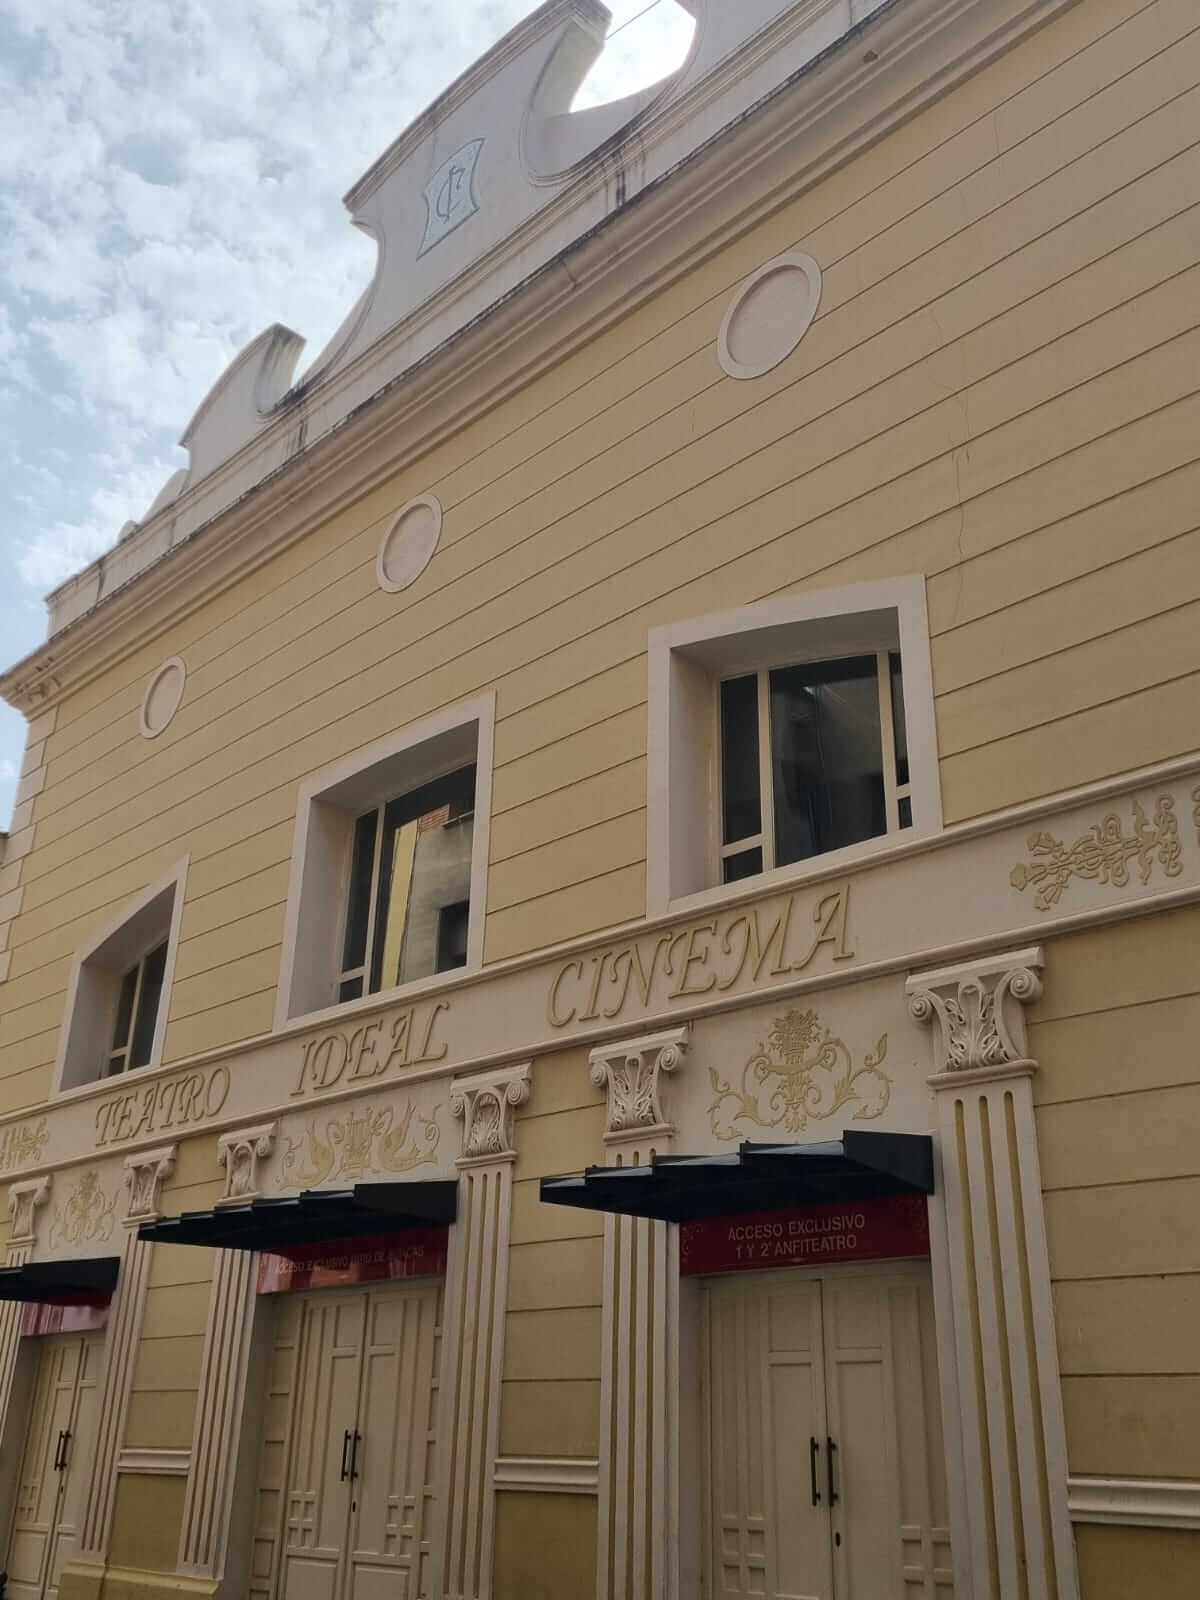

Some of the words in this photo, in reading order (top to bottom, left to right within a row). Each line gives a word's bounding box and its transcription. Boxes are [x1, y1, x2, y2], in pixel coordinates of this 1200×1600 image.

[95, 1064, 231, 1147] TEATRO
[290, 1001, 450, 1097] IDEAL
[546, 884, 856, 1028] CINEMA
[728, 1222, 783, 1241] ACCESO
[788, 1213, 865, 1236] EXCLUSIVO
[746, 1245, 755, 1257] Y
[775, 1234, 857, 1256] ANFITEATRO
